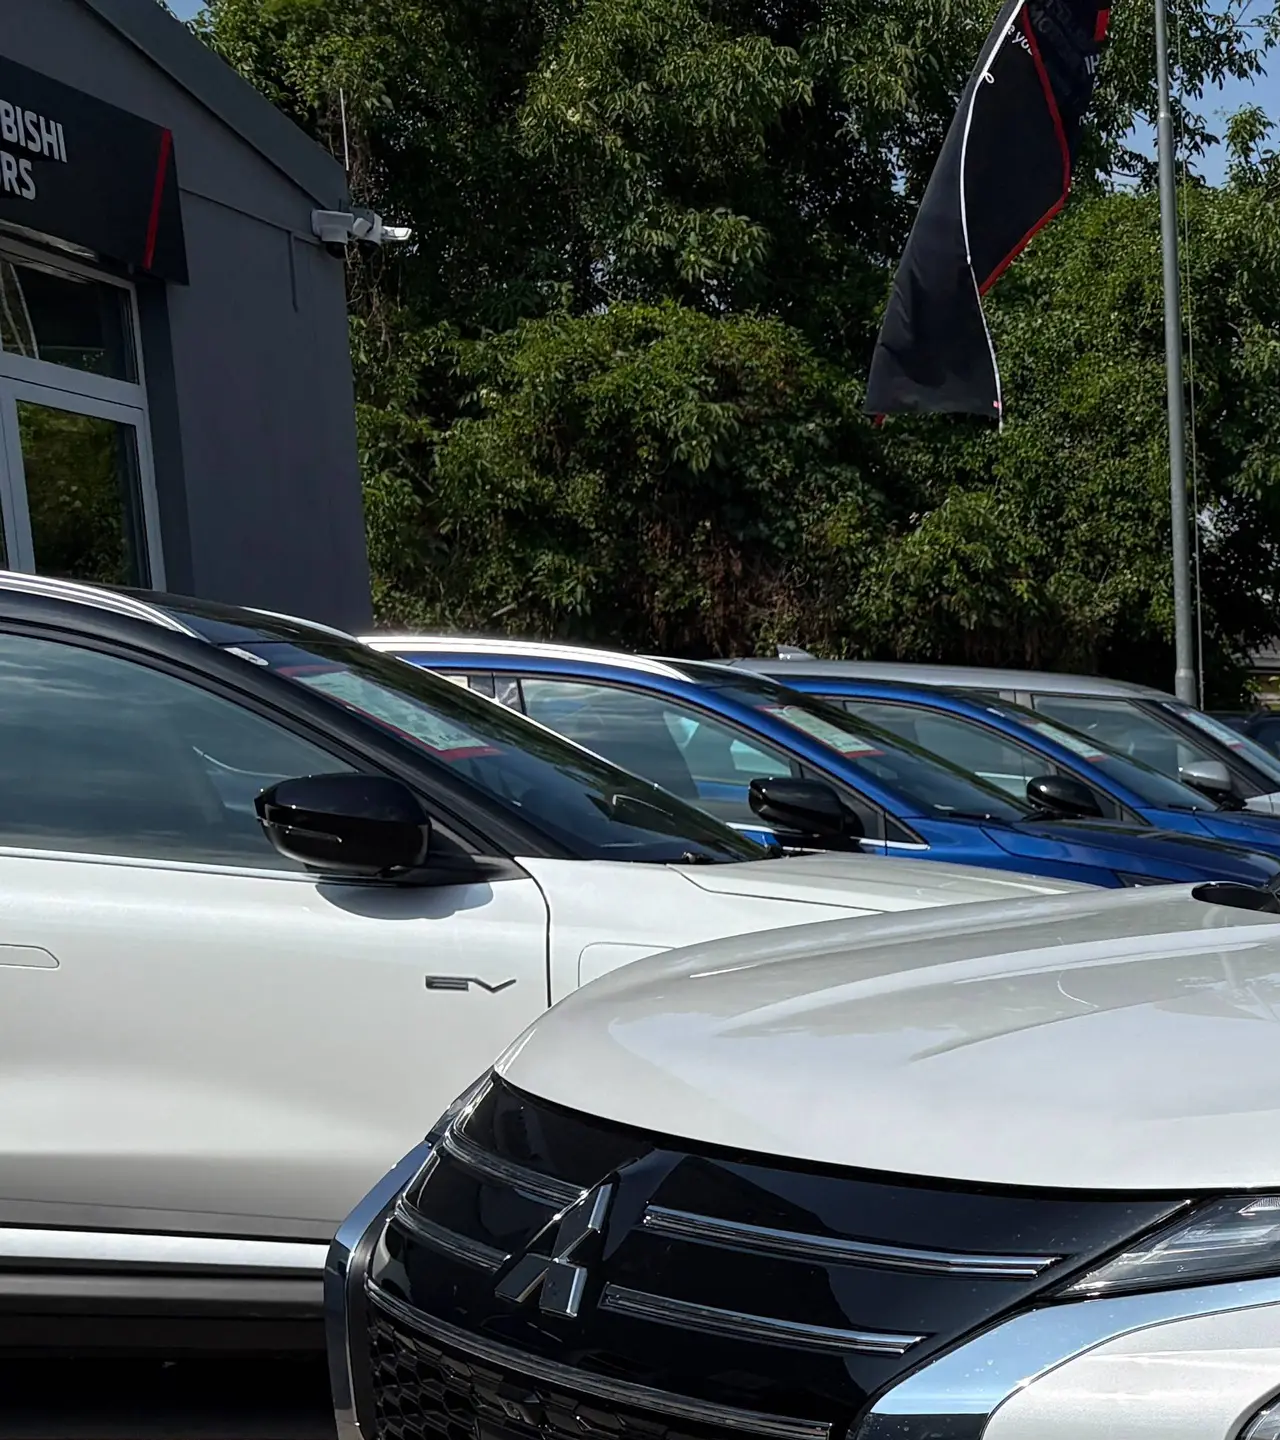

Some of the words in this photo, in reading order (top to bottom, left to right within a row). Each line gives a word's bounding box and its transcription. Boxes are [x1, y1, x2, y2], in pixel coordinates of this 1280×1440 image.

[0, 99, 67, 163] BISHI
[0, 151, 36, 200] RS
[425, 975, 517, 994] EV
